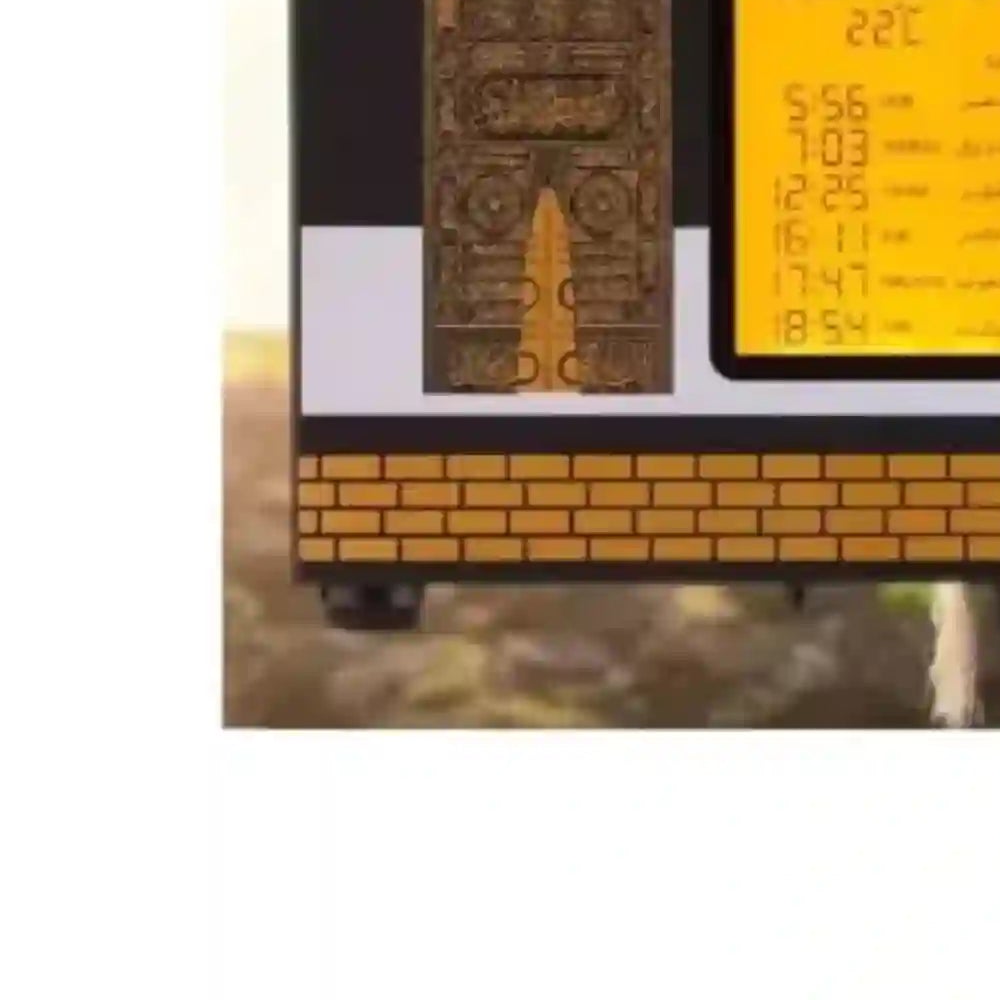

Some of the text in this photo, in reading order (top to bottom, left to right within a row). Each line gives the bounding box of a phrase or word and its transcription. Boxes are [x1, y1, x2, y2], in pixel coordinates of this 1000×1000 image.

[783, 81, 869, 122] 5:56
[786, 126, 869, 167] 7:03
[773, 262, 869, 299] 17:47
